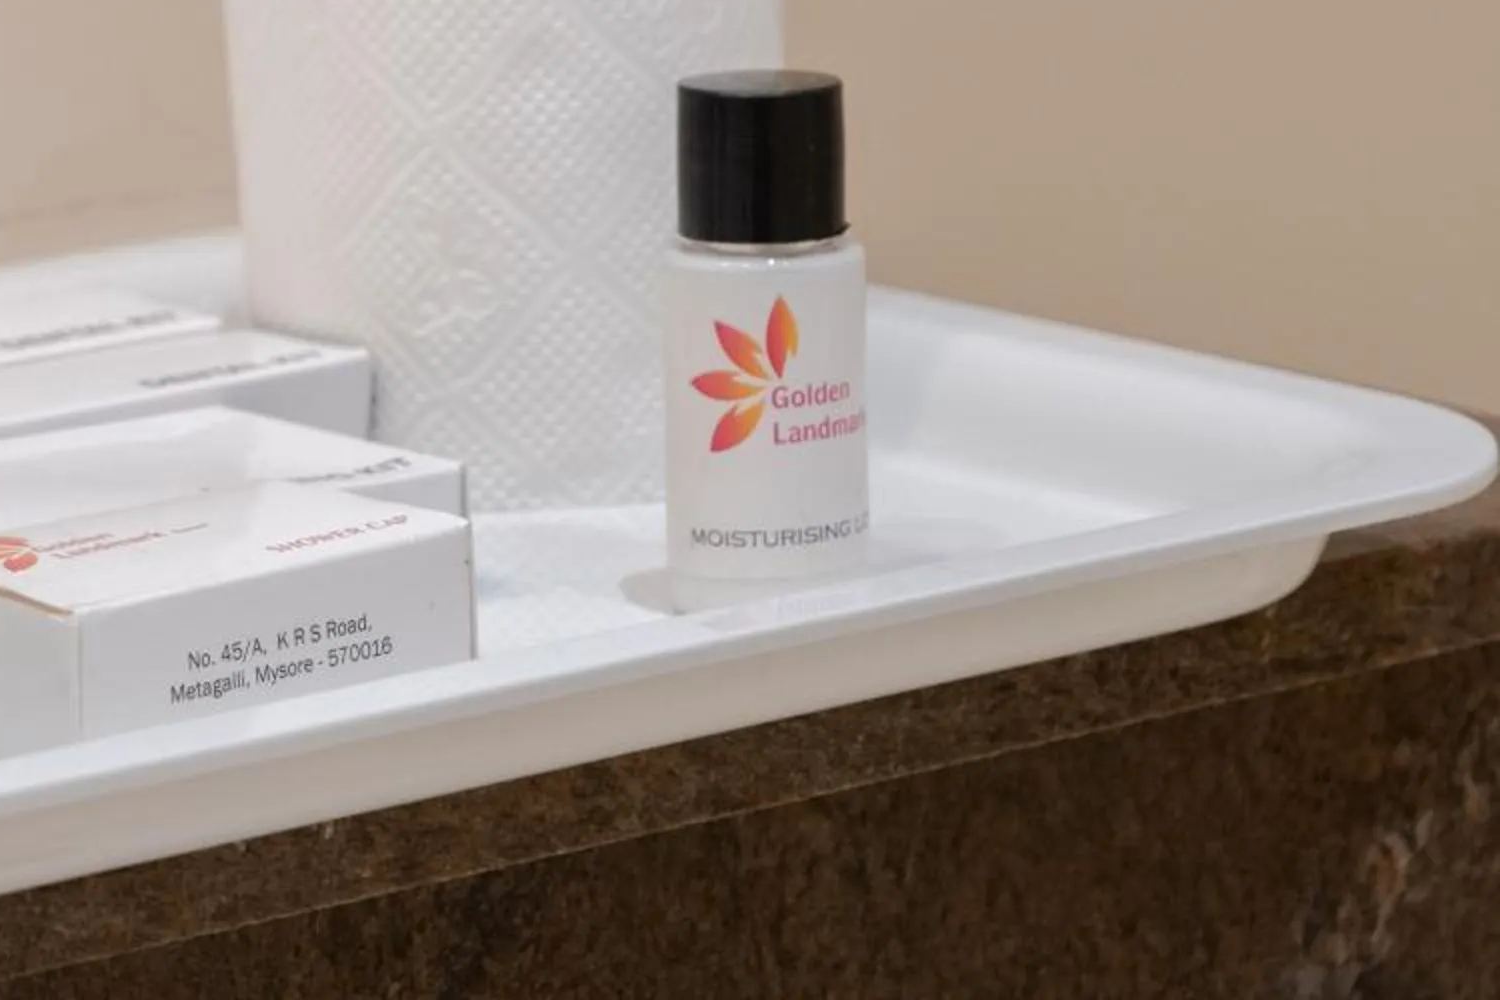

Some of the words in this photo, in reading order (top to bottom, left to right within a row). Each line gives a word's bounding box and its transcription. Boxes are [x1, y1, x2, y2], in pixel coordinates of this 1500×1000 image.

[771, 381, 851, 410] Golden
[691, 518, 851, 548] MOISTURISING
[188, 650, 217, 672] No.
[220, 636, 268, 663] 45/A,
[277, 630, 290, 649] K
[294, 627, 306, 646] R
[309, 623, 322, 643] S
[326, 614, 373, 639] Road,
[170, 670, 251, 704] Metagalli,
[255, 656, 315, 685] Mysore
[327, 635, 395, 668] 570016
